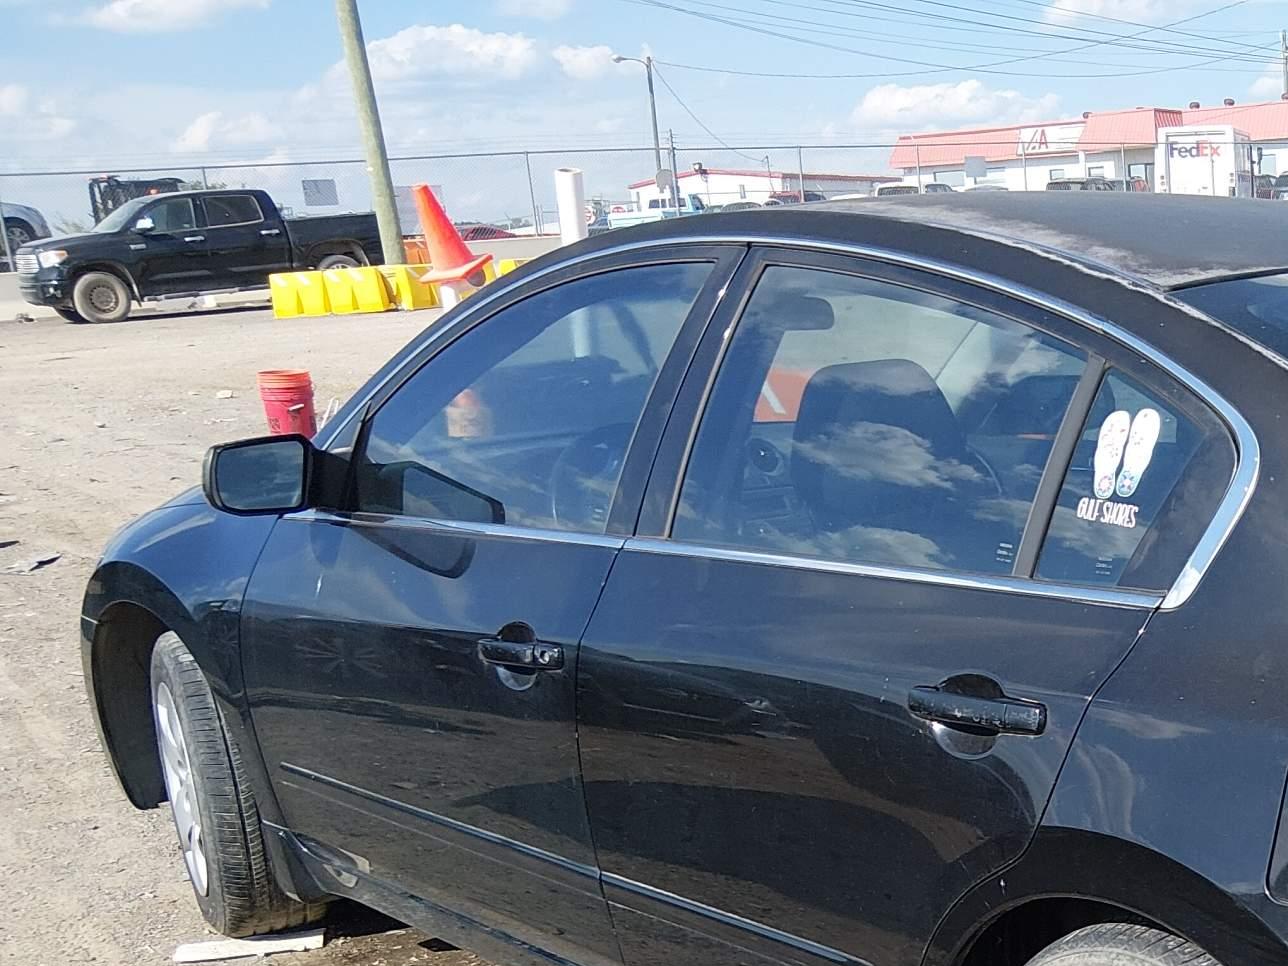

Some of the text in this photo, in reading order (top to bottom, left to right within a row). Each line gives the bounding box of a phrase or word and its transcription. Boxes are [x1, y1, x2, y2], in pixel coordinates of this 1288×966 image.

[1168, 139, 1221, 158] FedEx
[1077, 497, 1139, 528] GULF SHORES
